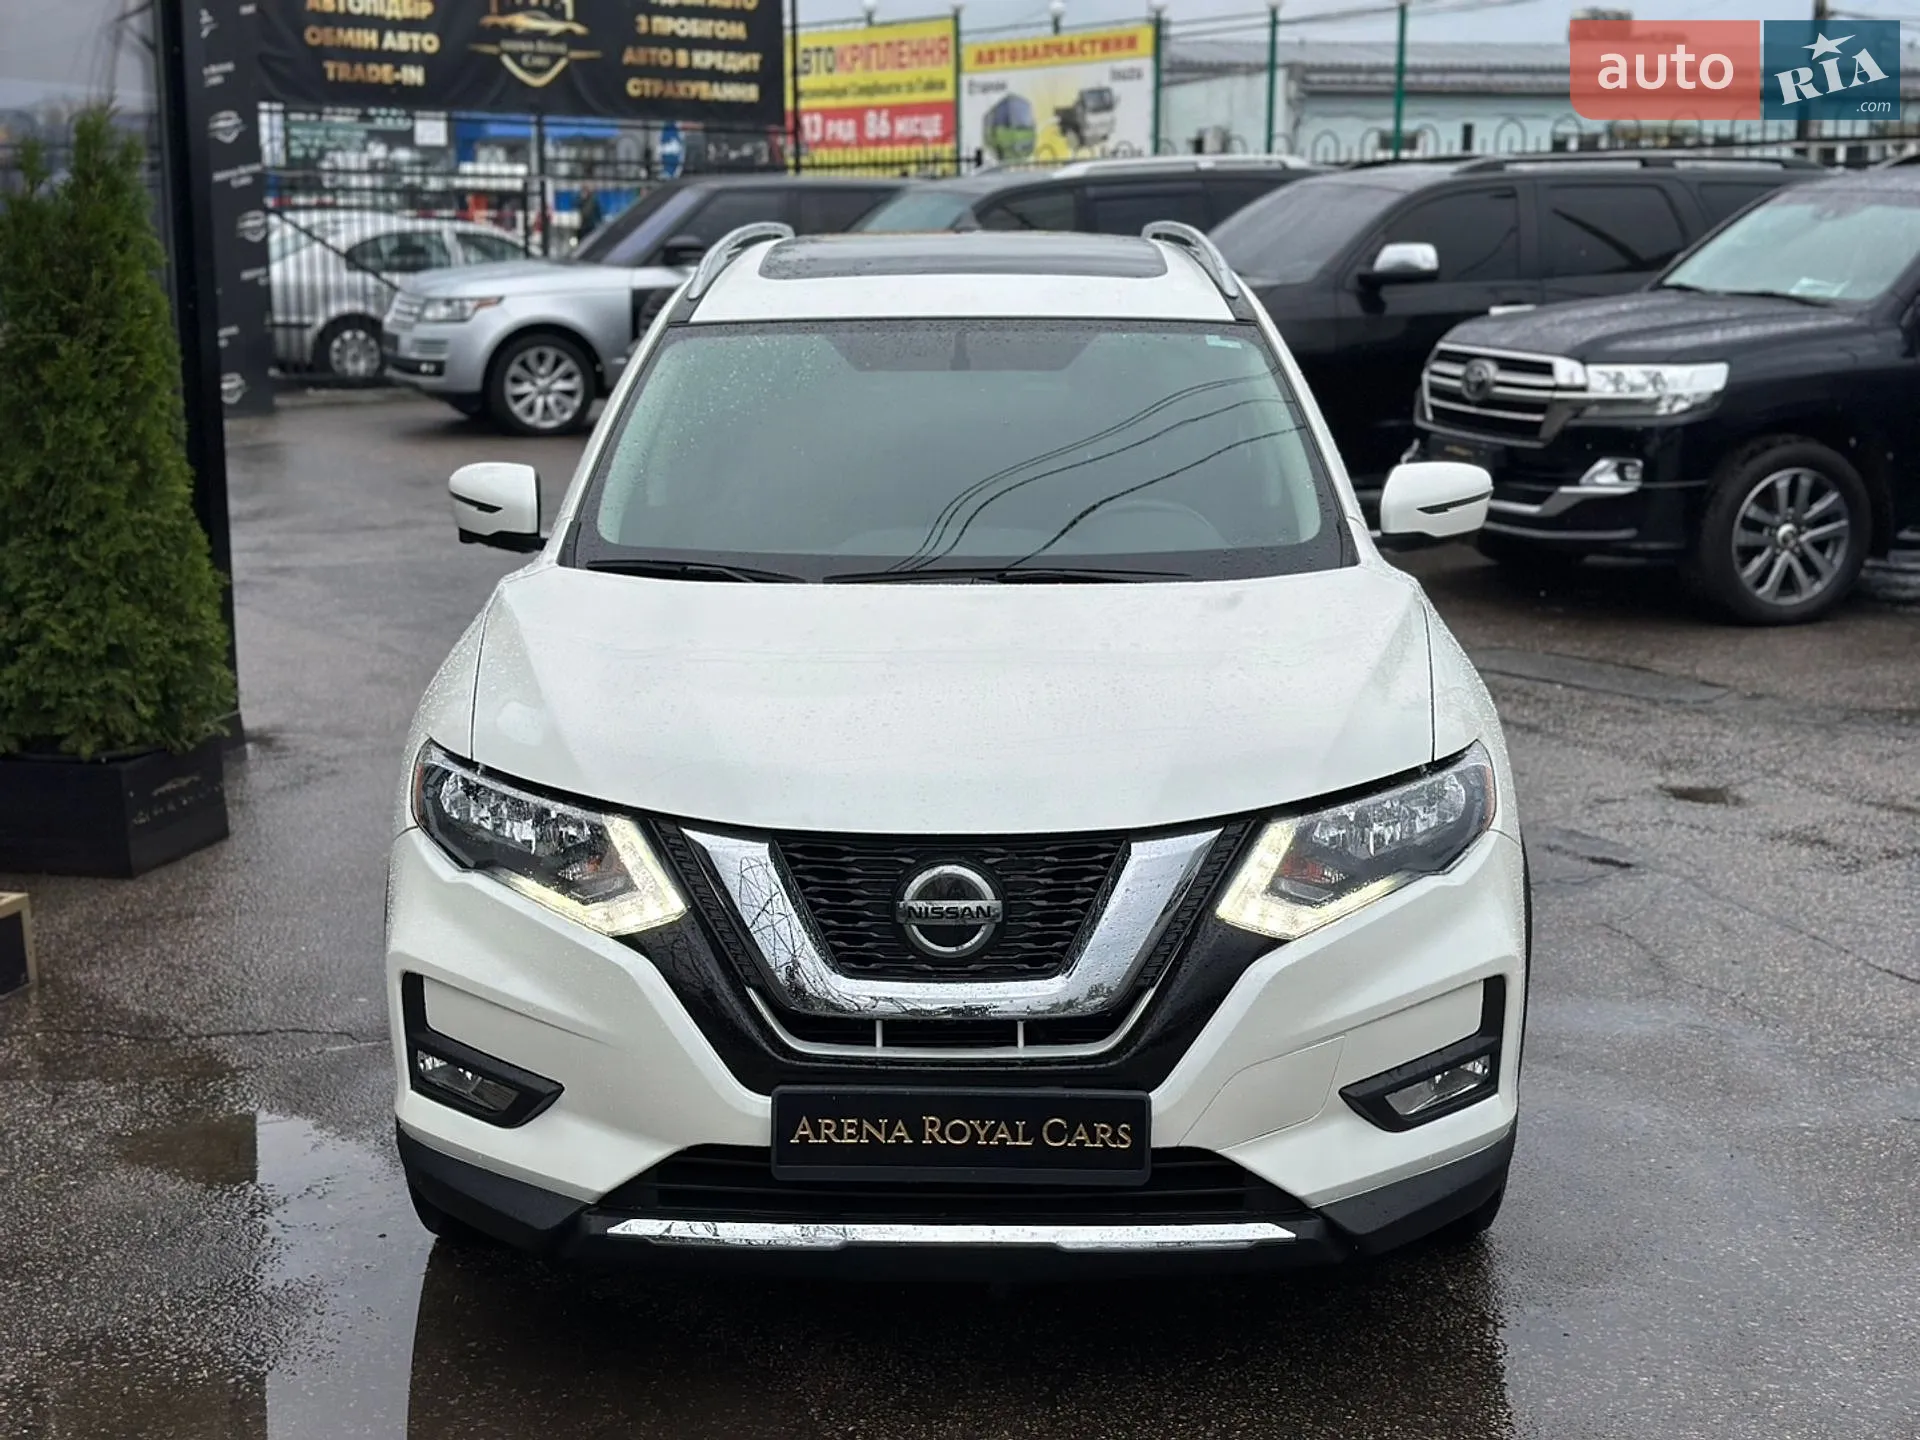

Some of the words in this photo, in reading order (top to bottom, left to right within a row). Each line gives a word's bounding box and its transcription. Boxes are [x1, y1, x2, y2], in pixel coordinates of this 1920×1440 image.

[305, 0, 434, 20] АВТОПІДБІР
[304, 25, 379, 50] ОБМІН
[381, 30, 440, 54] АВТО
[651, 15, 747, 40] ПРОБІГОМ
[622, 47, 673, 67] АВТО
[675, 48, 690, 69] В
[691, 49, 763, 74] КРЕДИТ
[797, 34, 950, 76] ВТОКРІПЛЕННЯ
[973, 34, 1139, 66] АВТОЗАПЧАСТИНИ
[323, 60, 425, 87] TRADE-IN
[626, 77, 760, 103] СТРАХУВАННЯ
[802, 112, 824, 143] 13
[907, 905, 991, 920] NISSAN
[789, 1115, 914, 1145] ARENA
[921, 1115, 1035, 1147] ROYAL
[1042, 1117, 1133, 1149] CARS
